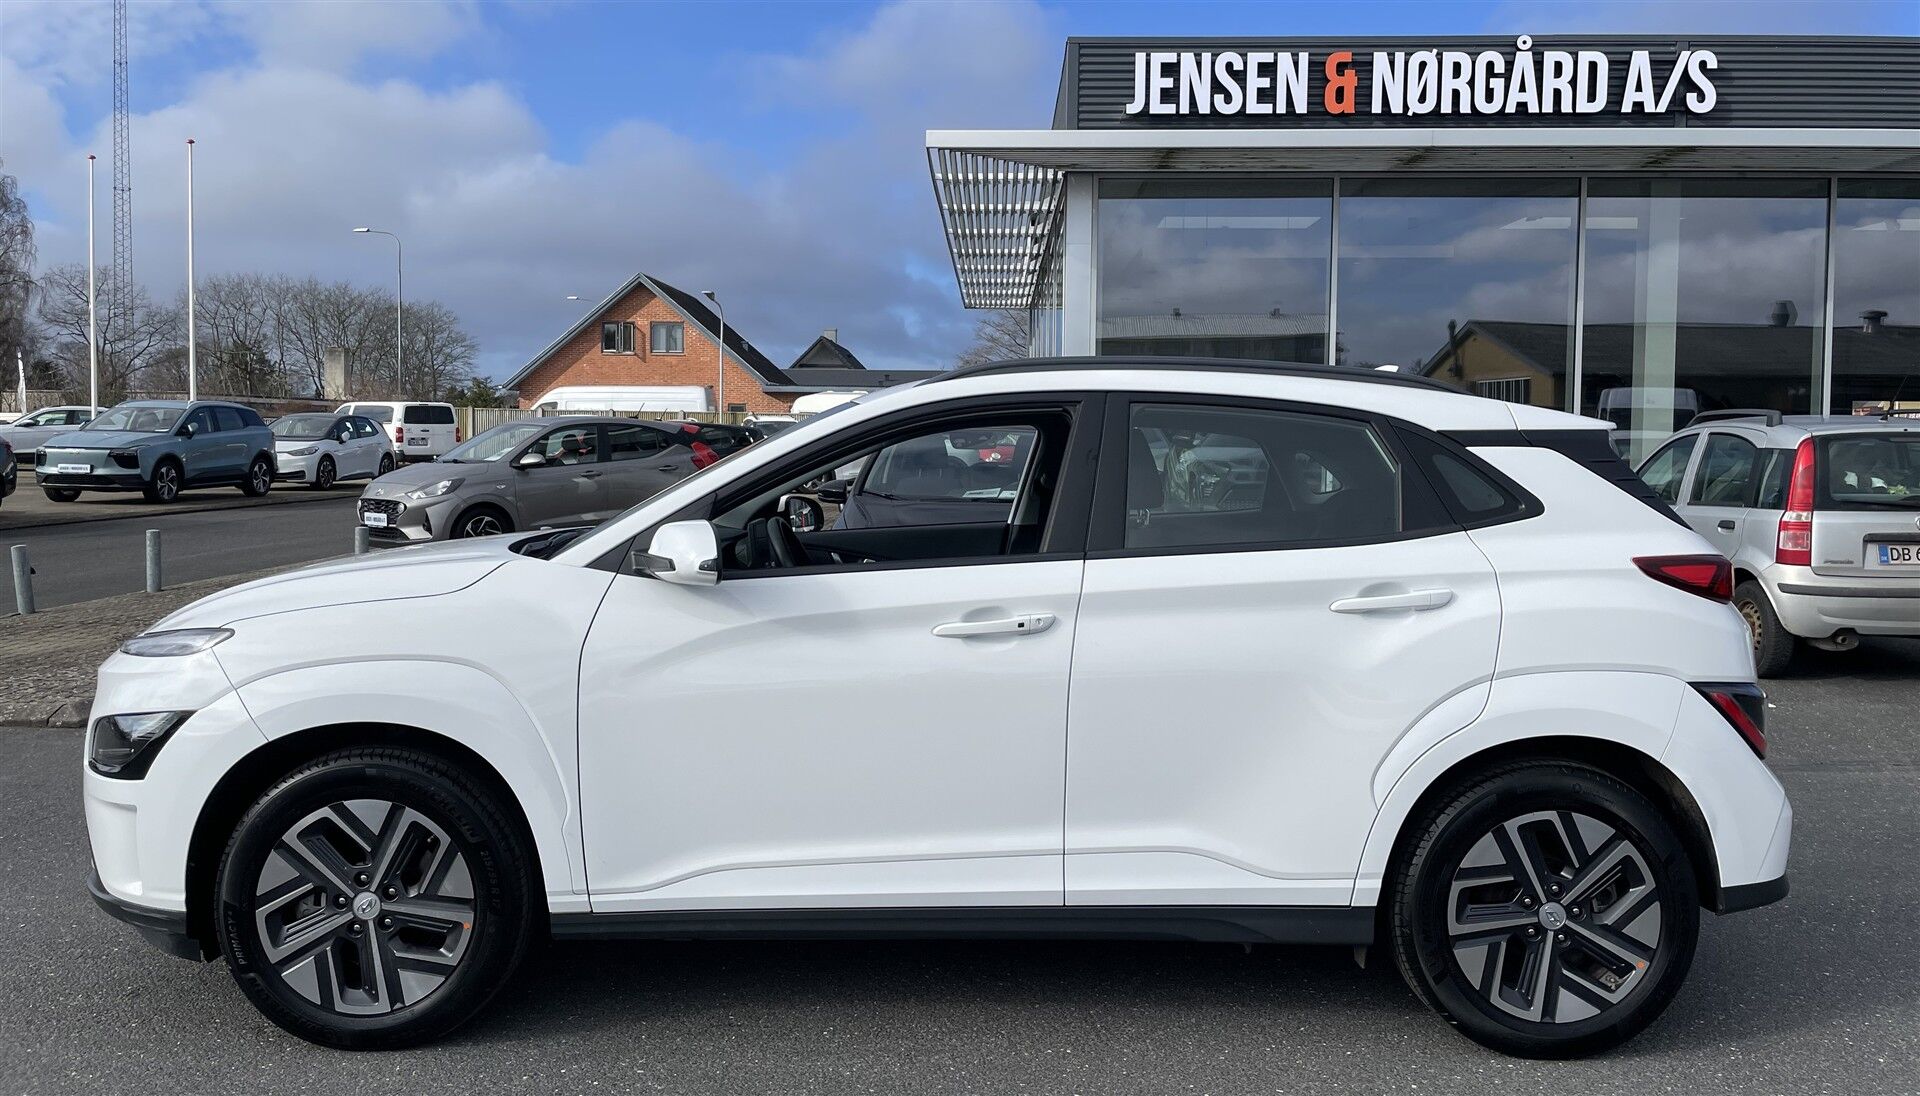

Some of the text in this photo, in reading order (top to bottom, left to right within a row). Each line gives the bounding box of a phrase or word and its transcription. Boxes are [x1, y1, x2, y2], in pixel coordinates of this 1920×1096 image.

[1126, 35, 1718, 117] JENSEN & NØRGÅRD A/S
[1890, 547, 1912, 562] DB
